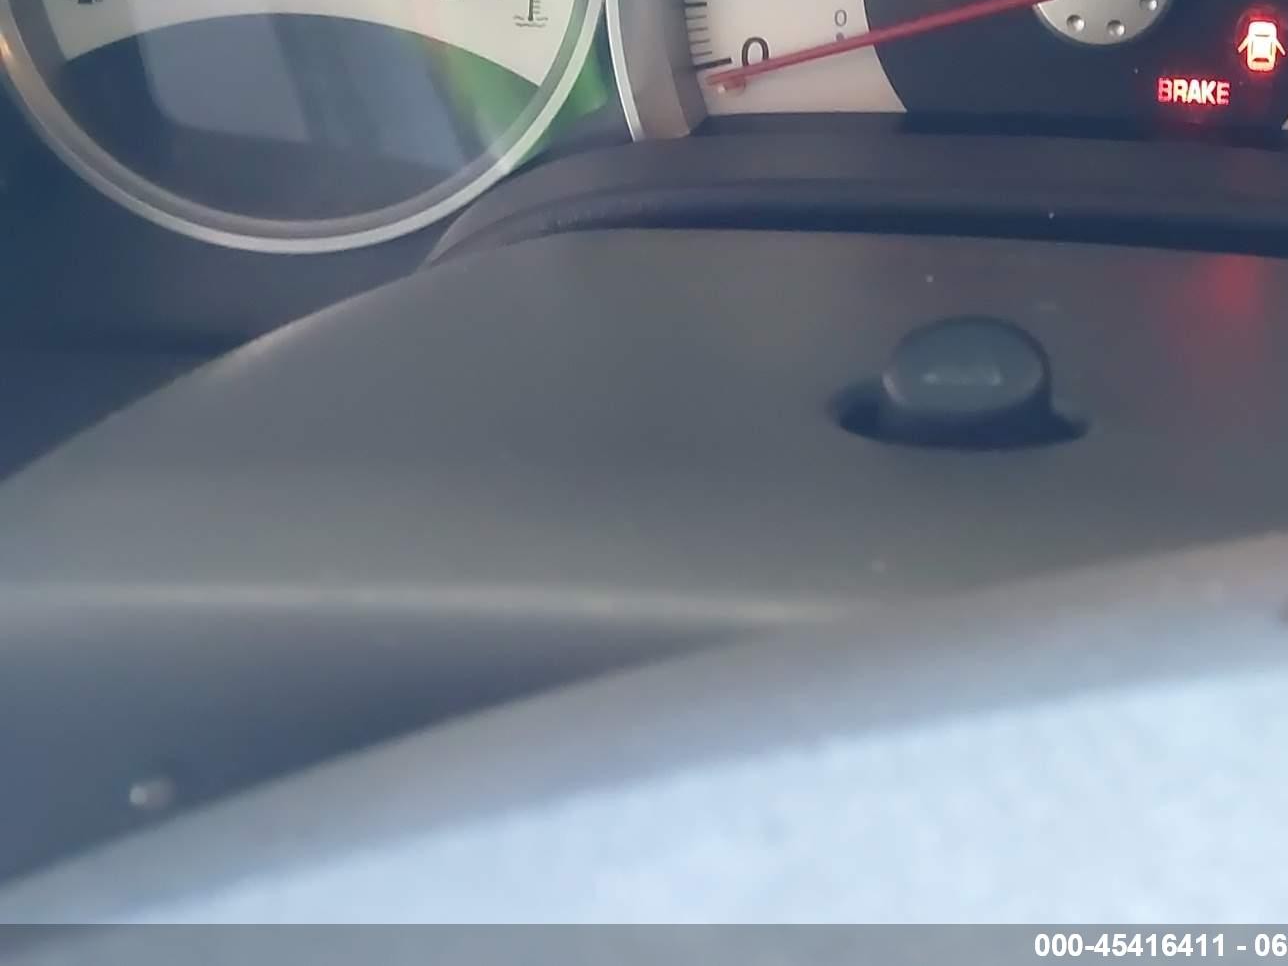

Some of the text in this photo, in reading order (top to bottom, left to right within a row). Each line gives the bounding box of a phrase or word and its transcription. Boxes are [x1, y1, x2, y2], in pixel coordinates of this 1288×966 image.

[834, 10, 848, 27] 0
[741, 37, 770, 68] 0
[1157, 77, 1231, 106] BRAKE
